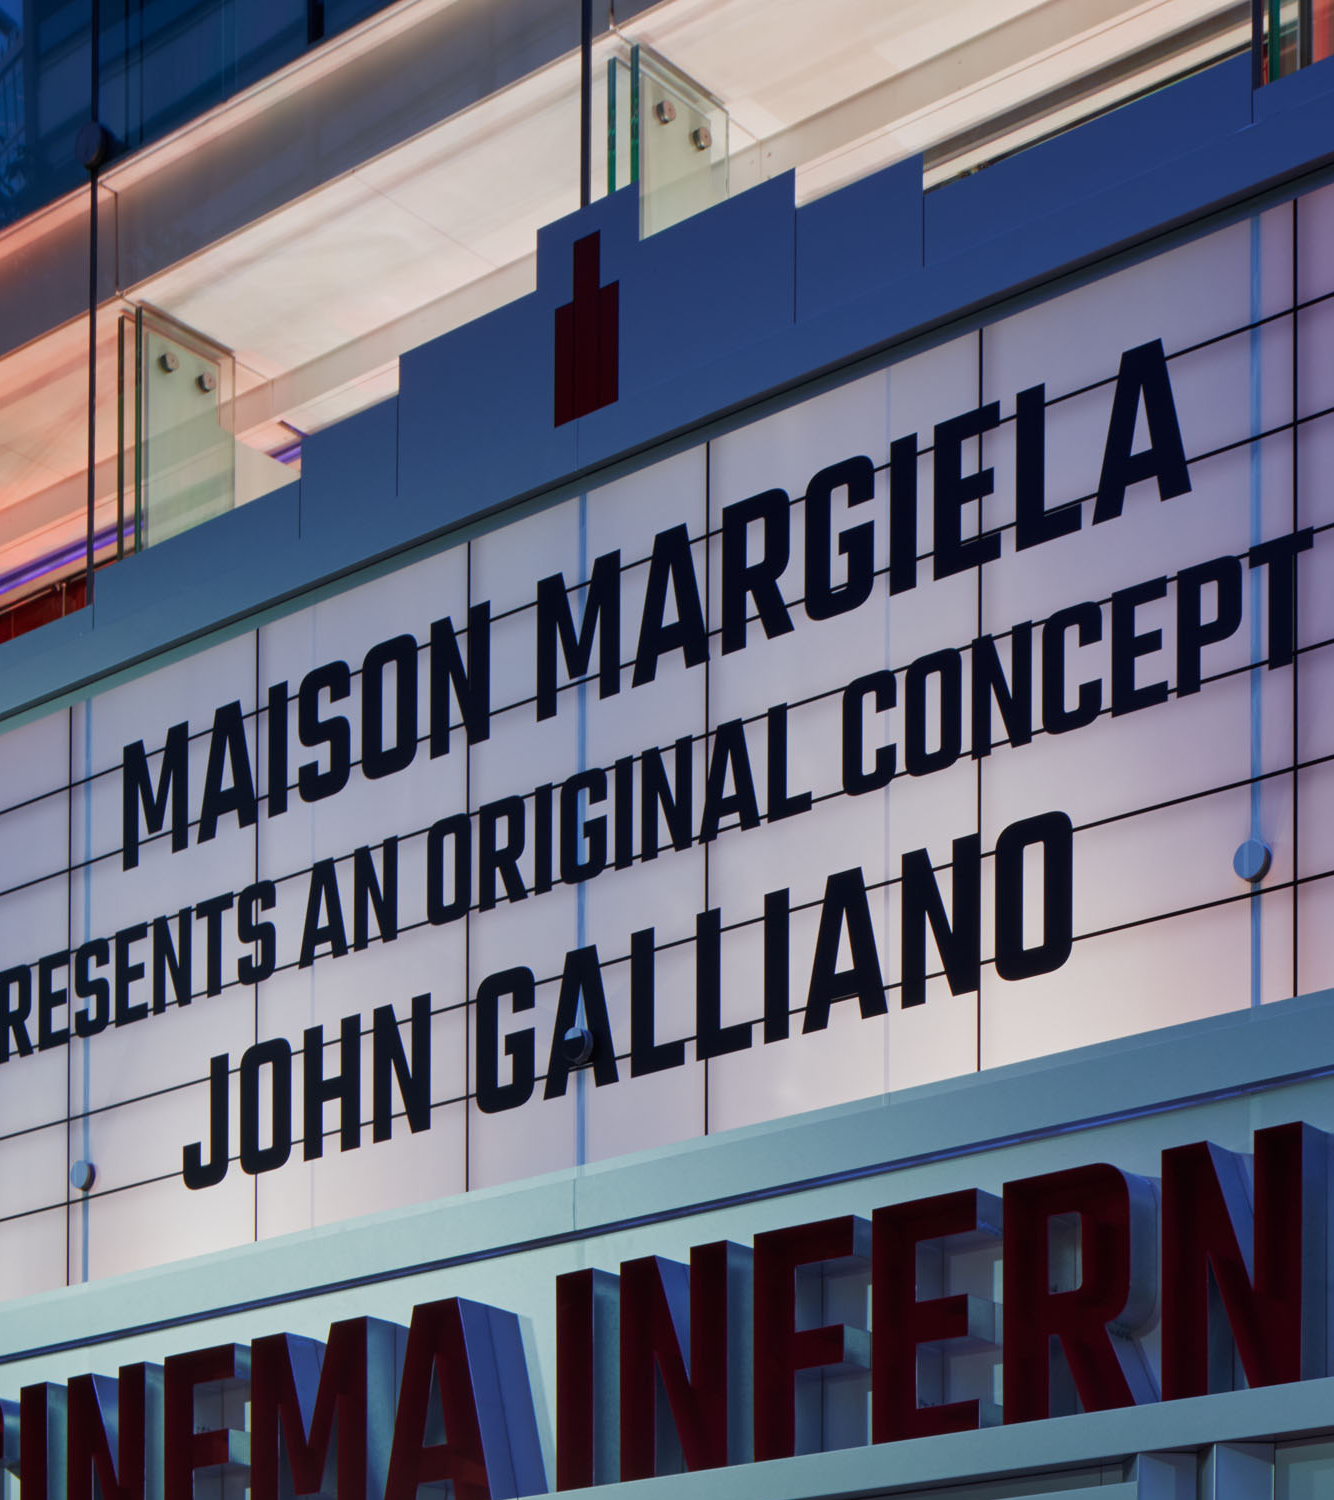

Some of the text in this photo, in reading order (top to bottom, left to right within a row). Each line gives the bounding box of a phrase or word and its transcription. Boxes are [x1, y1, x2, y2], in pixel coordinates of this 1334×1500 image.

[121, 340, 1192, 870] MAISON MARGIELA
[299, 837, 399, 968] AN
[426, 700, 814, 927] ORIGINAL
[841, 527, 1315, 797] CONCEPT
[182, 810, 1075, 1191] JOHN GALLIANO
